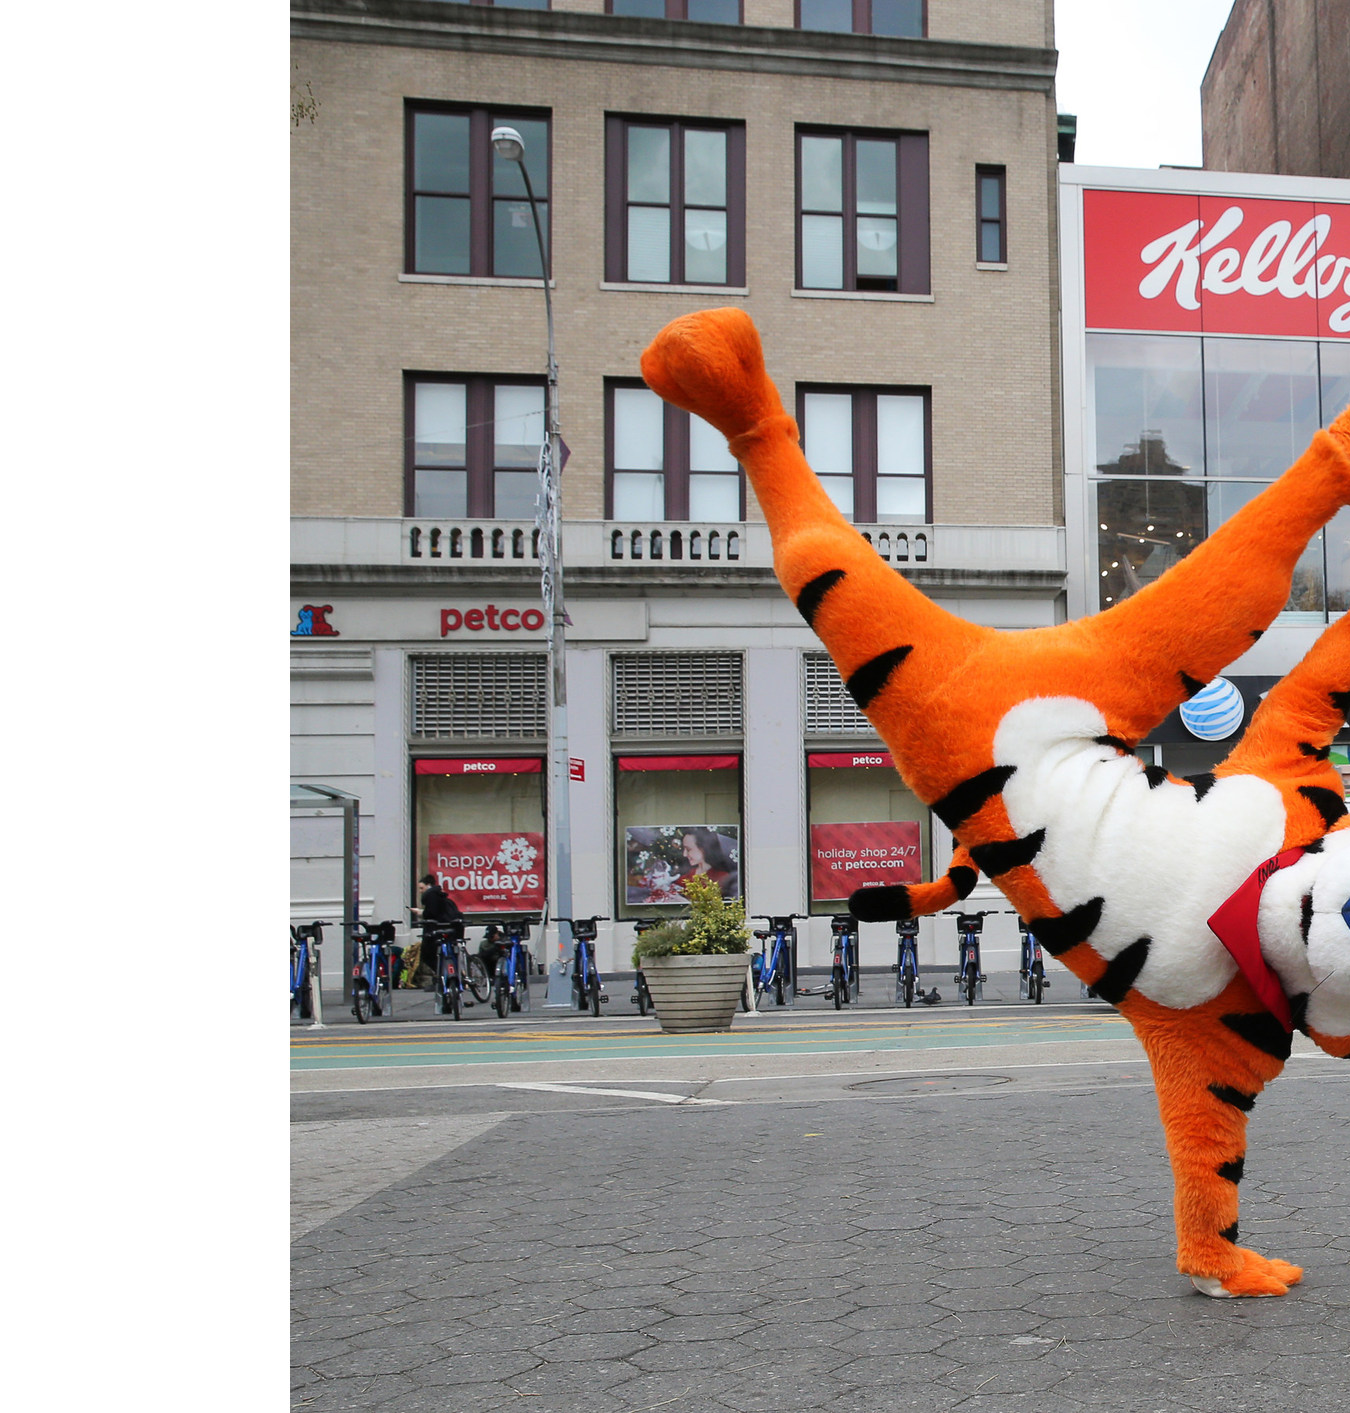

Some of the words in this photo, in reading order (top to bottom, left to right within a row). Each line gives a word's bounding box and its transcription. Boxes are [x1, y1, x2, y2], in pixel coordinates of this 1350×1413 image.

[440, 604, 545, 638] petco
[463, 762, 496, 772] petco
[852, 756, 883, 766] petco
[817, 849, 857, 859] holiday
[860, 847, 888, 858] shop
[890, 845, 917, 856] 24/7
[437, 853, 497, 870] happy
[831, 861, 842, 870] at
[845, 859, 904, 871] petco.com
[436, 870, 539, 894] holidays
